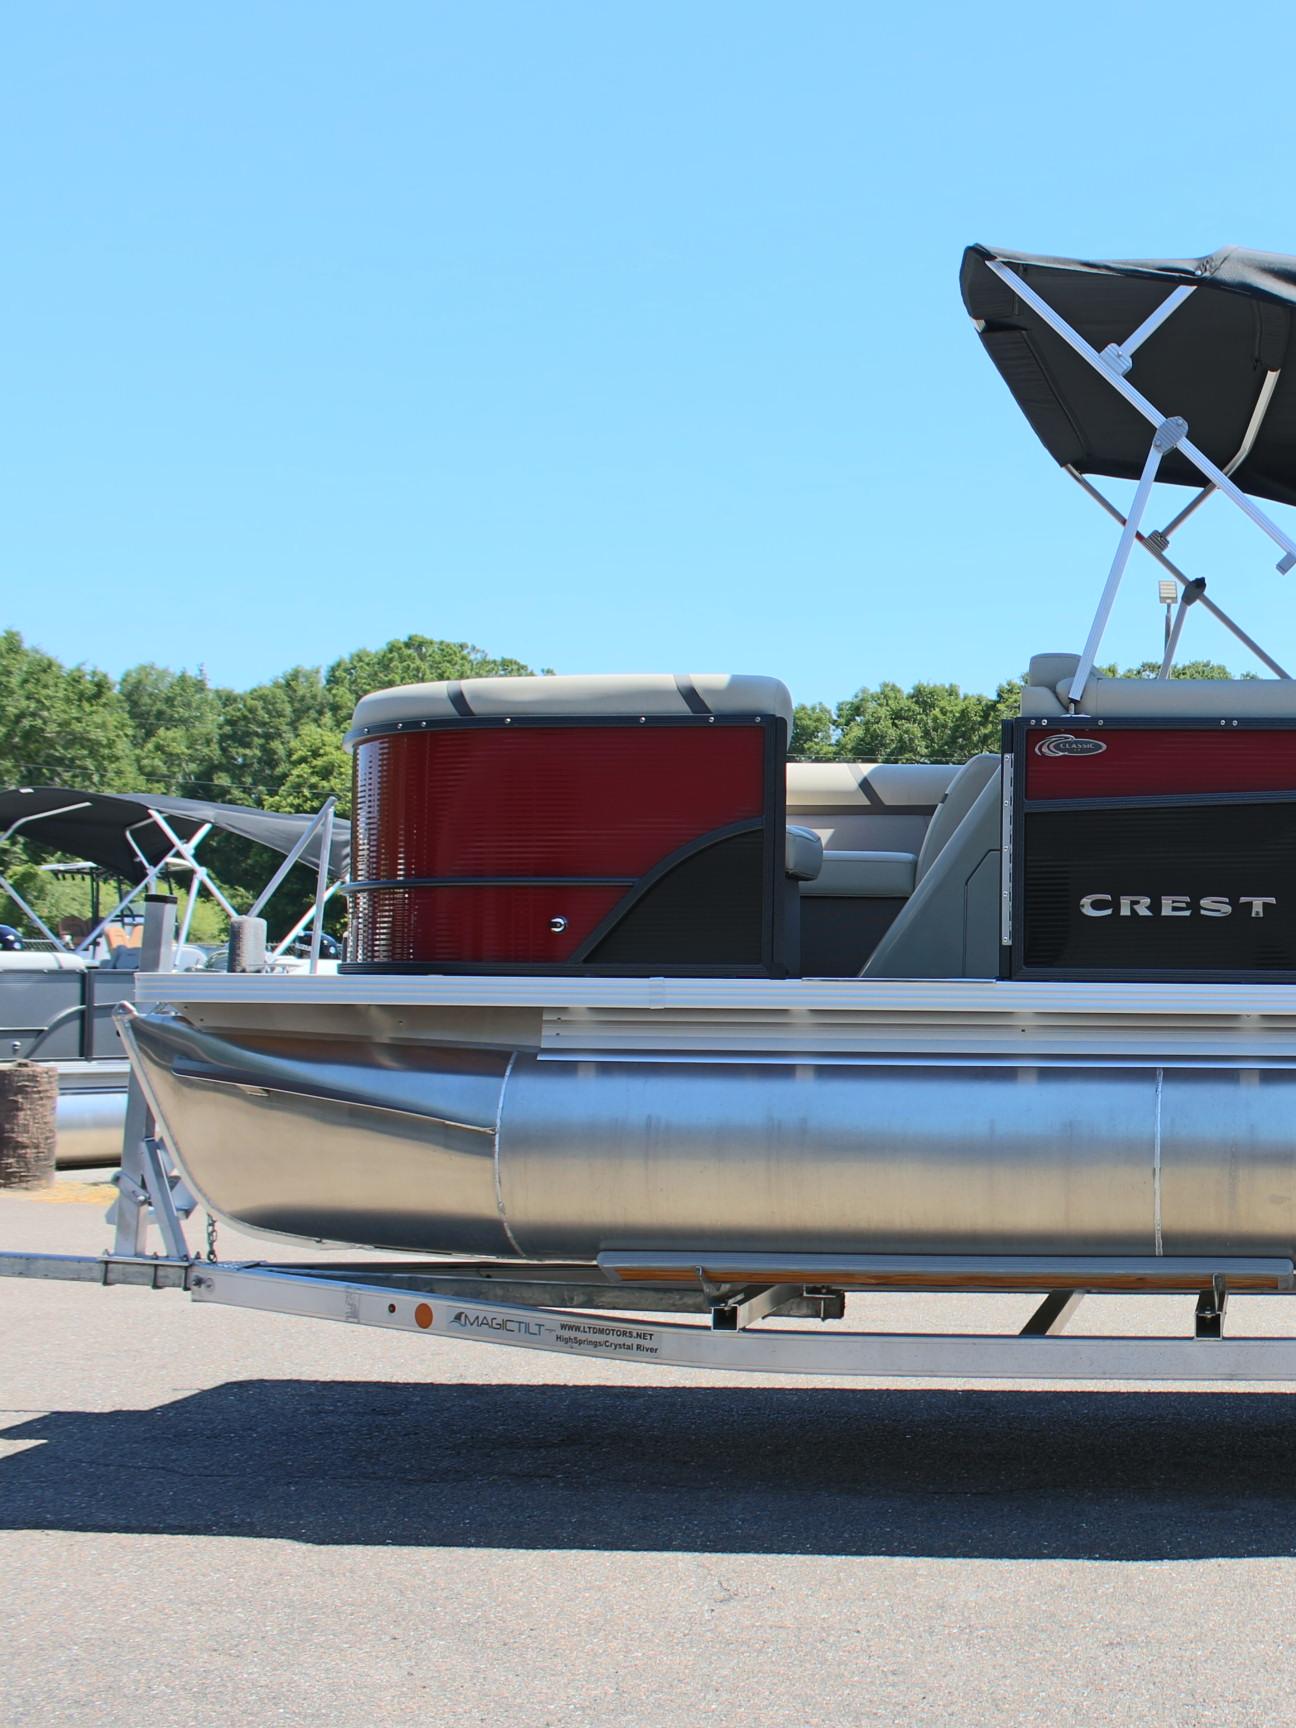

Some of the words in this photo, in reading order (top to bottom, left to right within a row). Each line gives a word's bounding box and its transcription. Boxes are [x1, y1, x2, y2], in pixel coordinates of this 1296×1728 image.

[1079, 894, 1277, 917] CREST
[464, 1313, 545, 1336] MAGICTILT
[560, 1323, 654, 1340] WWW.LTDMOTORS.NET
[636, 1343, 659, 1353] River
